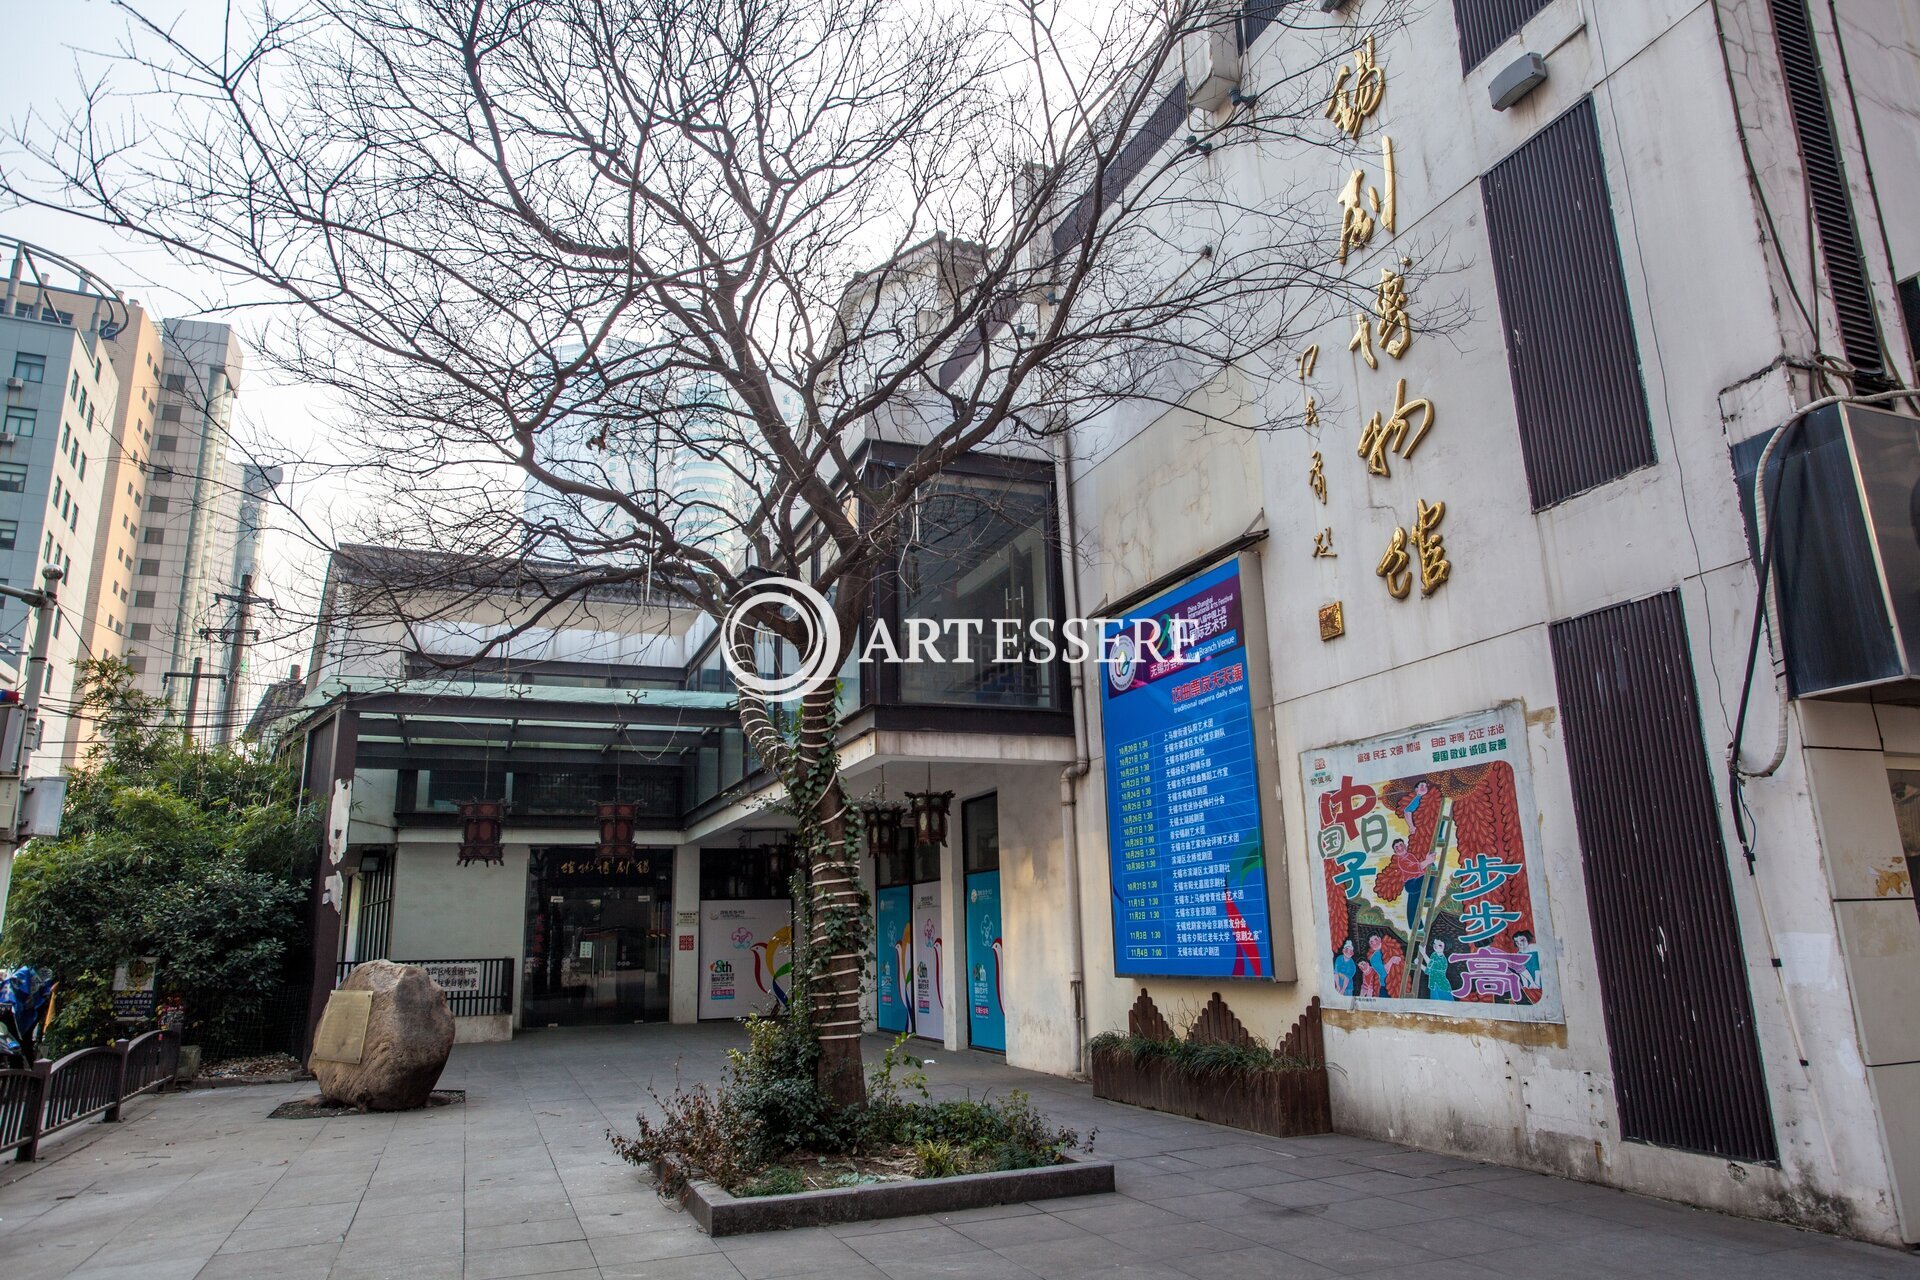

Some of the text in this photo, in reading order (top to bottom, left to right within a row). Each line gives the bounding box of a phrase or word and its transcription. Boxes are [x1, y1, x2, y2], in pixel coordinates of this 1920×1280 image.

[1190, 615, 1228, 640] 国际艺术节
[1199, 644, 1217, 656] Branch
[1217, 637, 1235, 649] Venue
[1172, 663, 1243, 704] 戏曲票友天天演
[1174, 700, 1197, 713] traditional
[1215, 690, 1229, 699] daily
[1229, 685, 1243, 695] show
[1357, 724, 1505, 764] 富强 民主 文明 和谐 自由 平等 公正 法治
[1432, 738, 1507, 763] 爱国 敬业 诚信 友善
[1448, 853, 1532, 1002] 步步高
